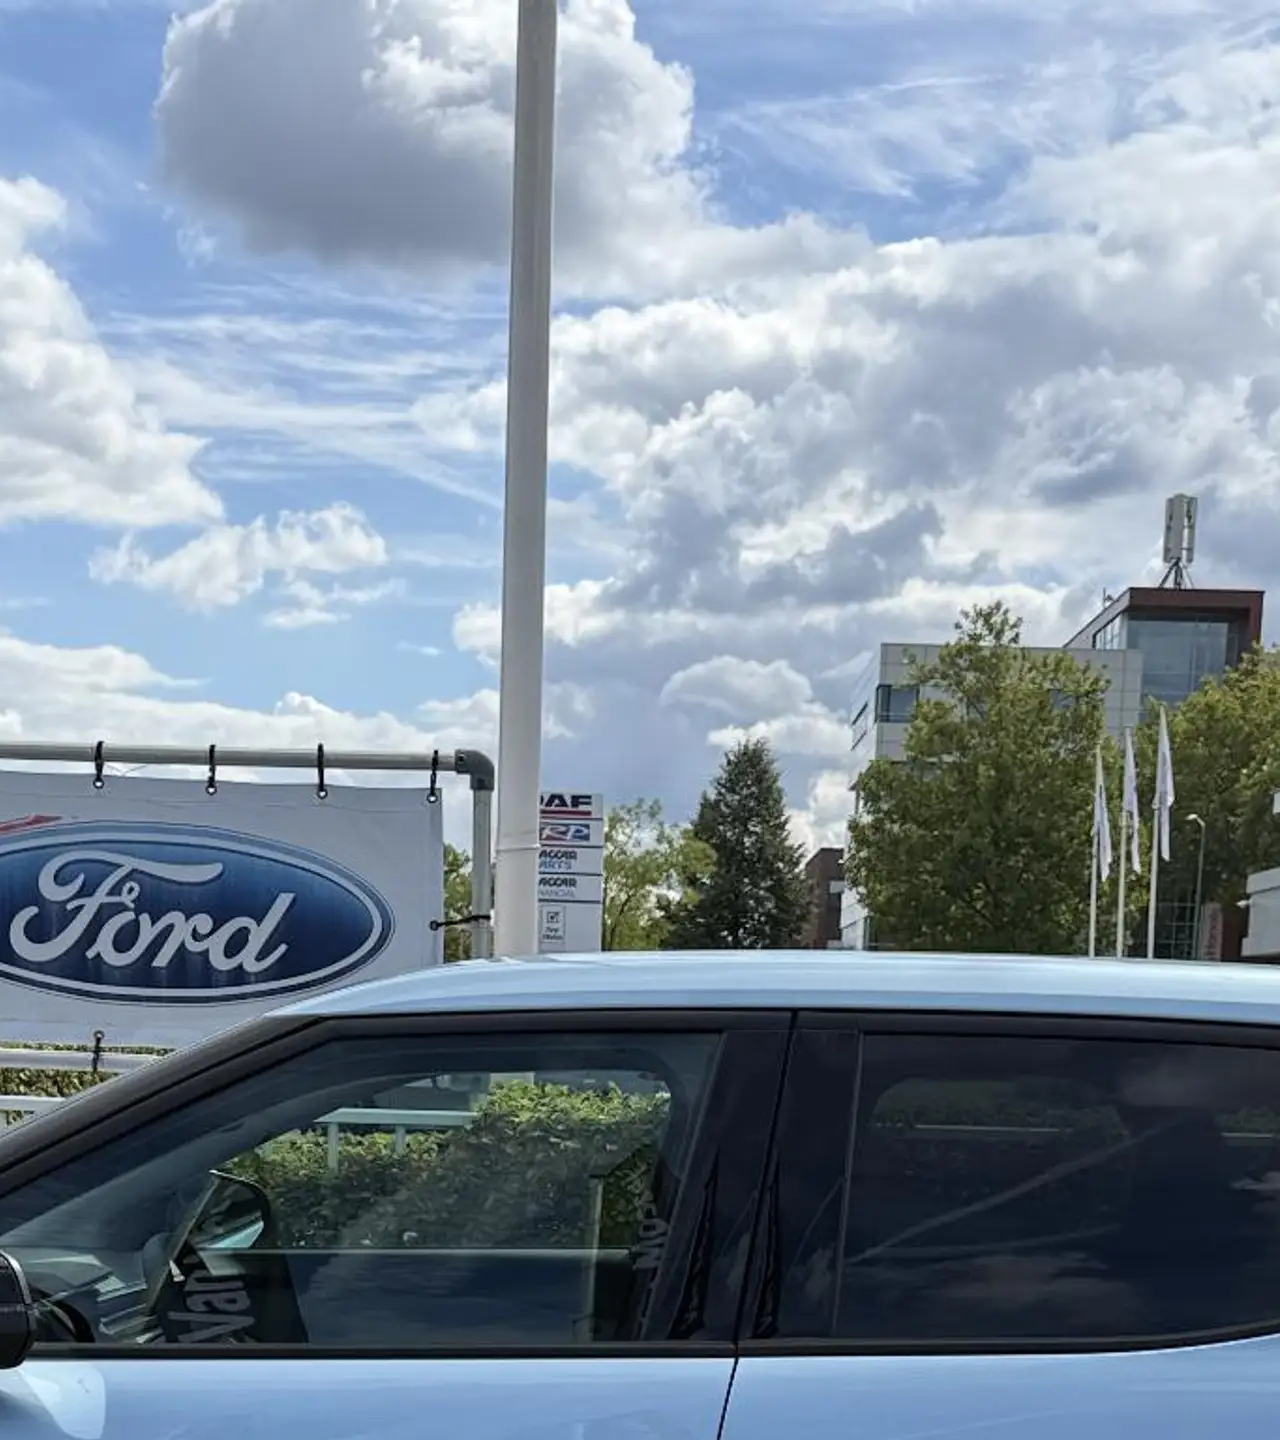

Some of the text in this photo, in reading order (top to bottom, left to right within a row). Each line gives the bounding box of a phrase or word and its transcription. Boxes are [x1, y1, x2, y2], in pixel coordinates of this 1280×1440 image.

[540, 794, 593, 809] AF
[539, 824, 590, 841] RP
[539, 849, 578, 860] ACCAR
[539, 877, 578, 888] ACCAR
[9, 850, 297, 974] Ford
